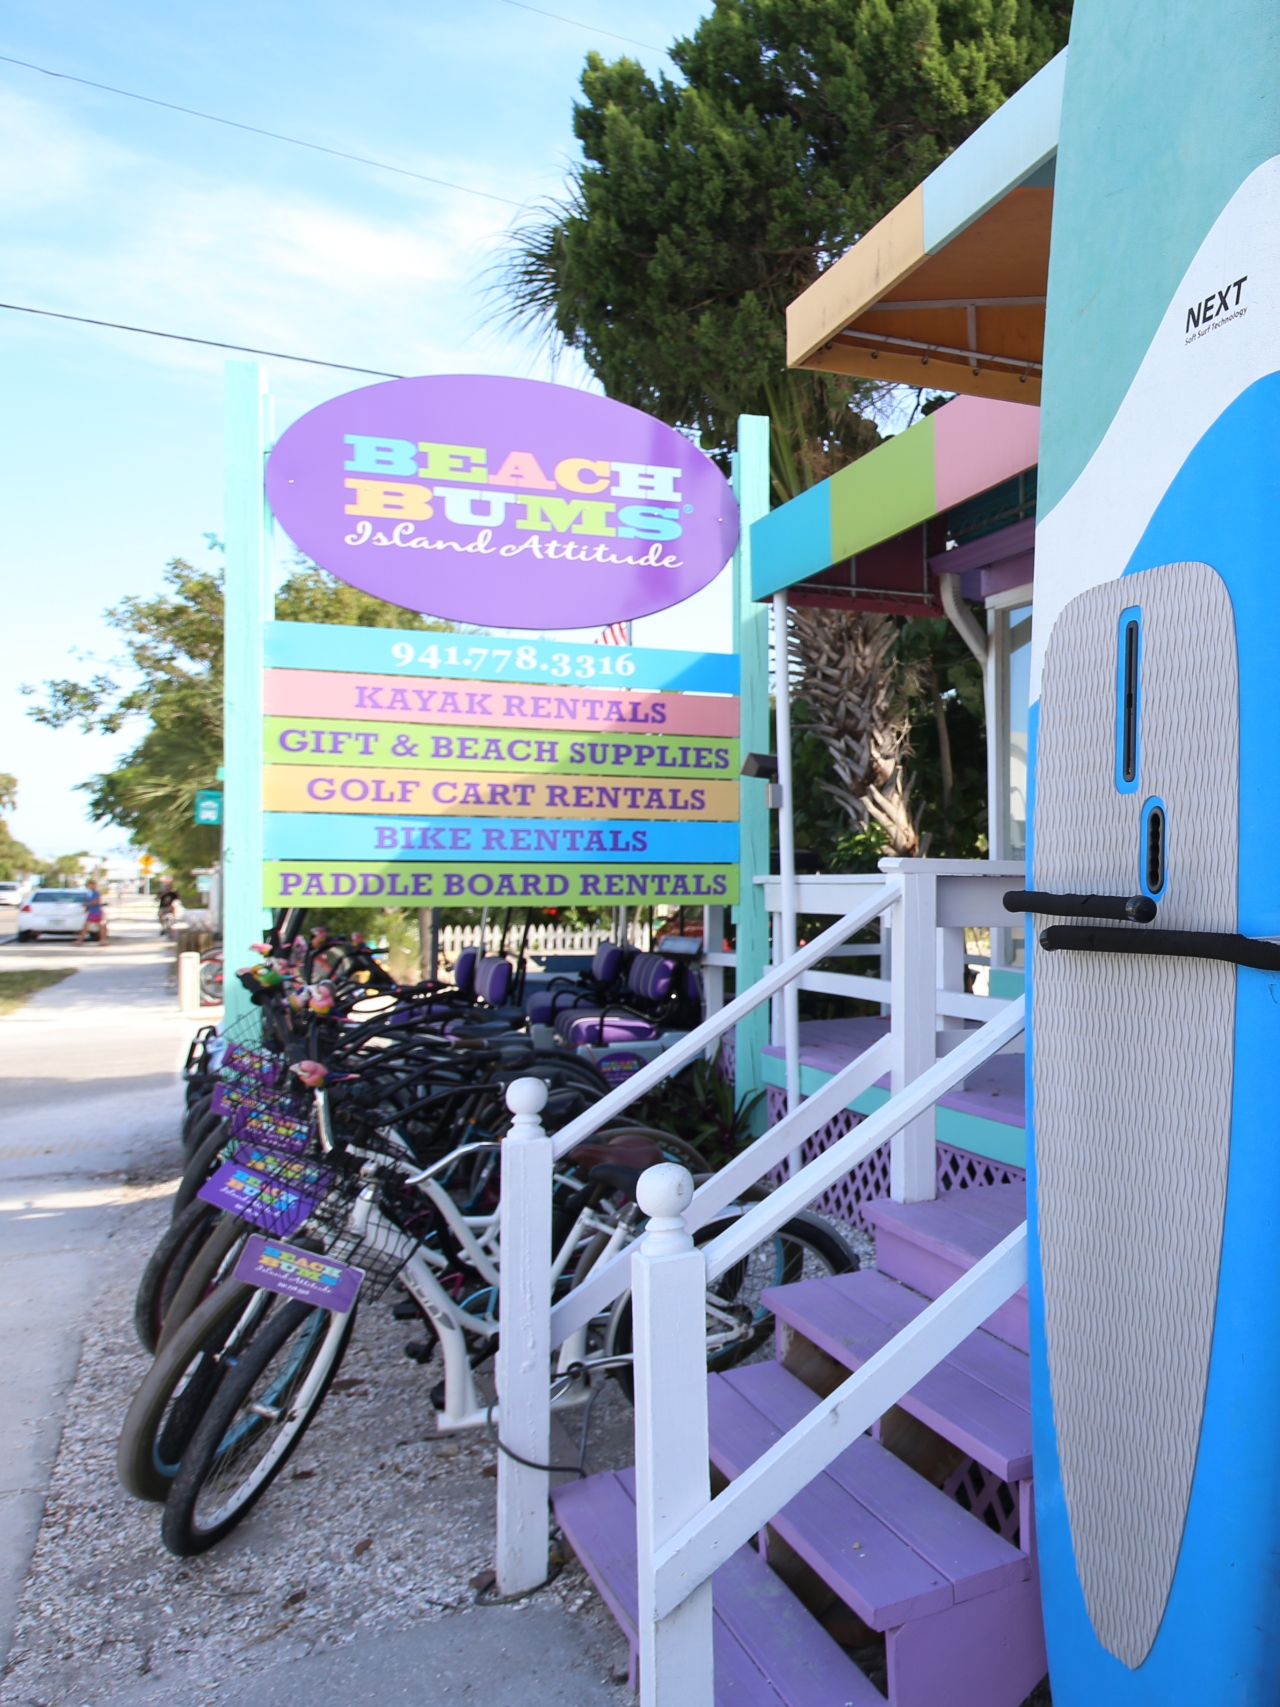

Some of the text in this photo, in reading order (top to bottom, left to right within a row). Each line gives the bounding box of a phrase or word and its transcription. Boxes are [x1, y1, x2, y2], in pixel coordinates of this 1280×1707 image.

[1185, 275, 1248, 334] NEXT
[1185, 307, 1247, 345] Soft Surf Technology
[343, 434, 683, 502] BEACH
[343, 478, 684, 542] BUMS
[344, 520, 684, 569] Island Attitude
[391, 642, 637, 679] 941.778.3316
[355, 685, 667, 724] KAYAK RENTALS
[278, 728, 731, 770] GIFT & BEACH SUPPLIES
[306, 778, 707, 812] GOLF CART RENTALS
[374, 825, 648, 853] BIKE RENTALS
[278, 872, 729, 897] PADDLE BOARD RENTALS
[263, 1245, 343, 1278] BEACH
